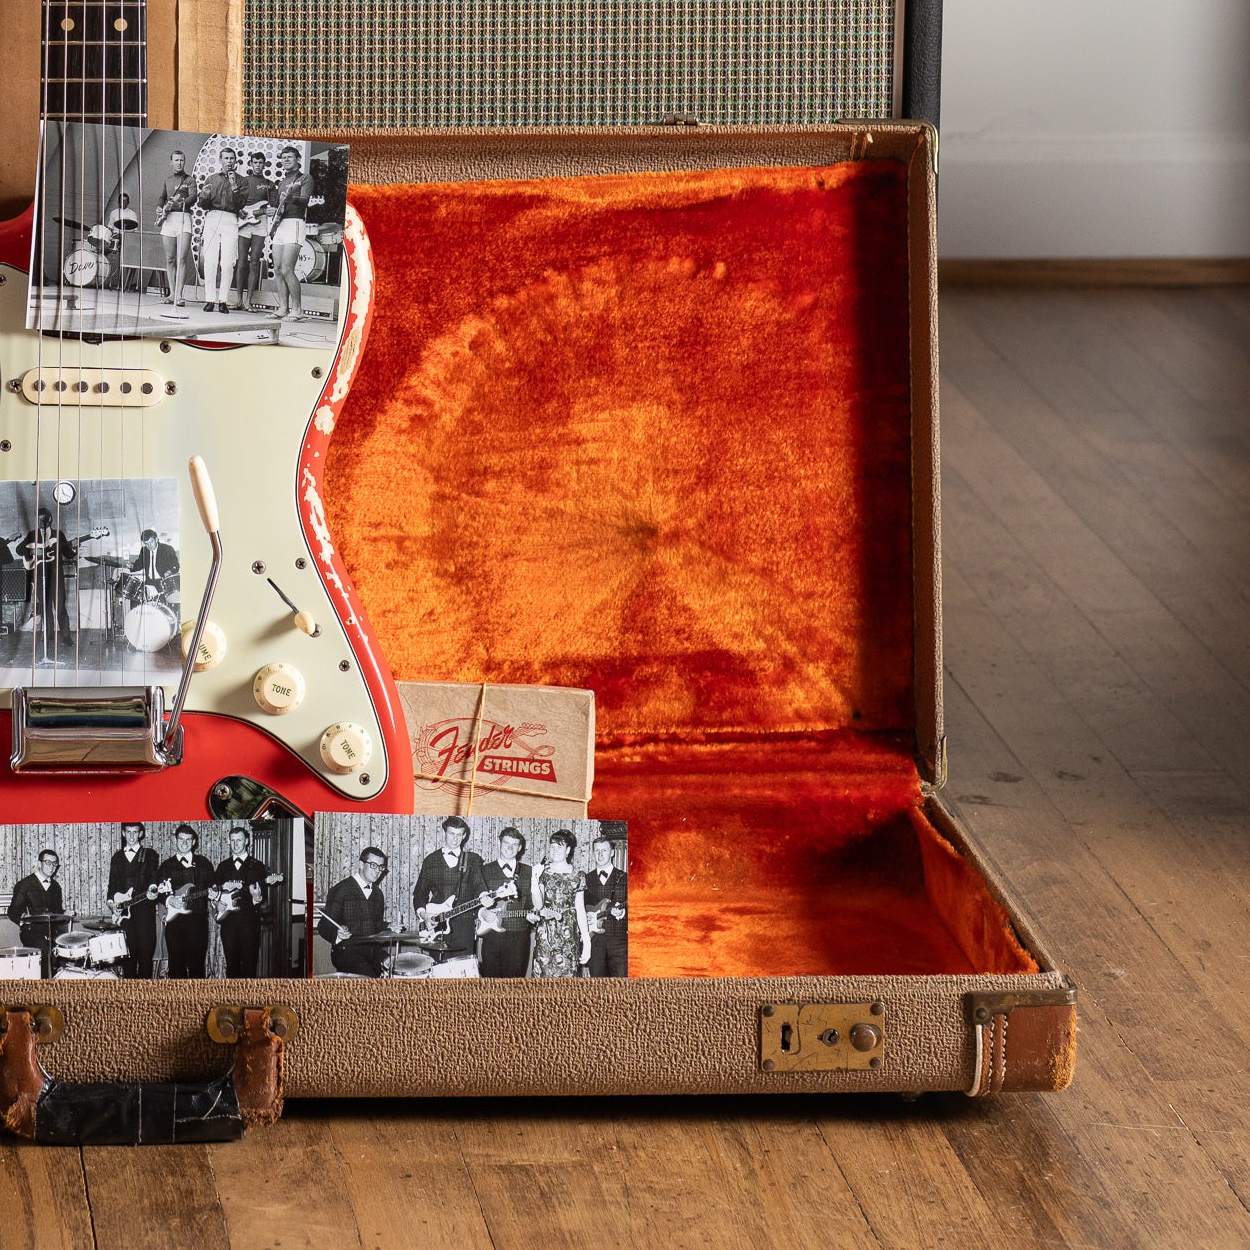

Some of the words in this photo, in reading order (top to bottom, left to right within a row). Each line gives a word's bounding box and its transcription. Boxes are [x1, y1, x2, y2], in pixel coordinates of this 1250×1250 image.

[272, 683, 292, 697] TONE
[340, 739, 356, 760] TONE
[430, 724, 515, 784] Fender
[483, 757, 551, 775] STRINGS
